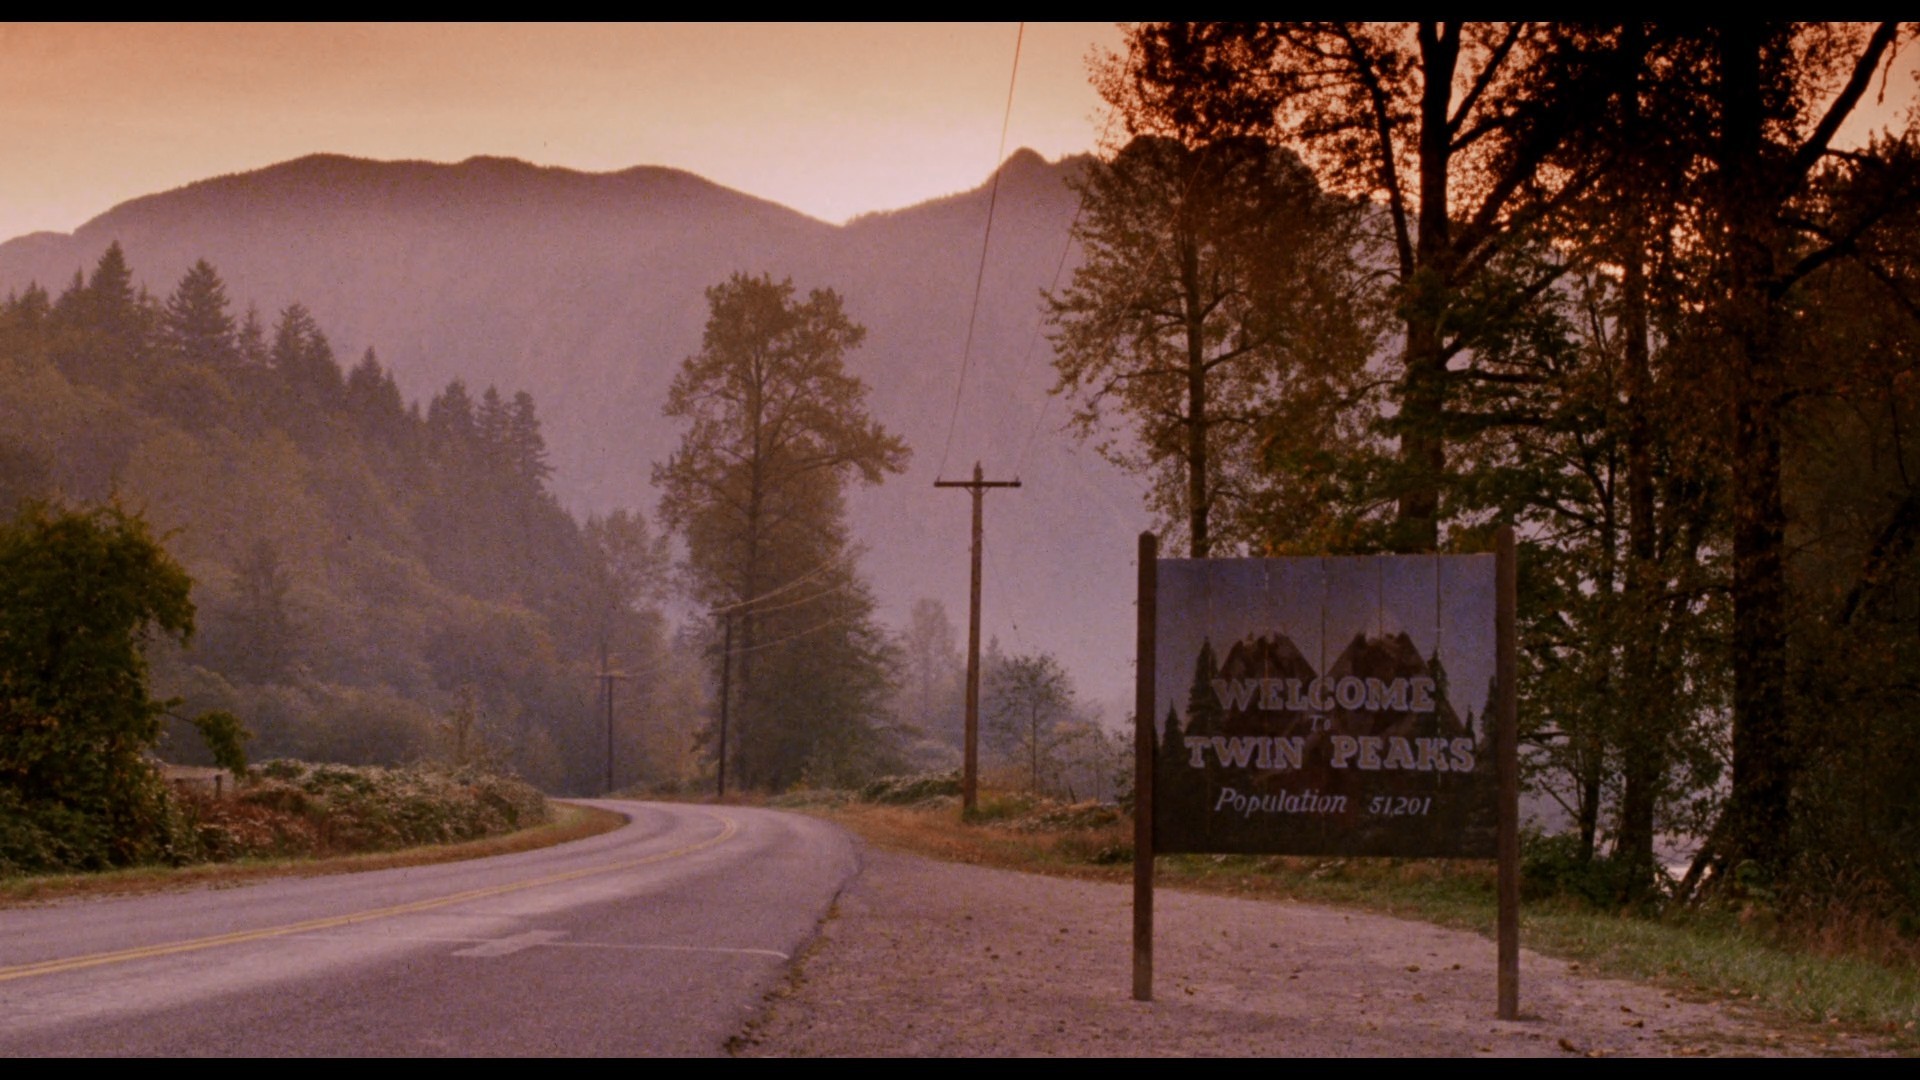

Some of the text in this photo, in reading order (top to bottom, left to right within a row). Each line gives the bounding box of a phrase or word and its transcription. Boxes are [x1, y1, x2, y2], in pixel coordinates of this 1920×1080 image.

[1211, 676, 1436, 712] WELCOME
[1184, 735, 1476, 772] TWIN PEAKS
[1214, 788, 1347, 817] Population
